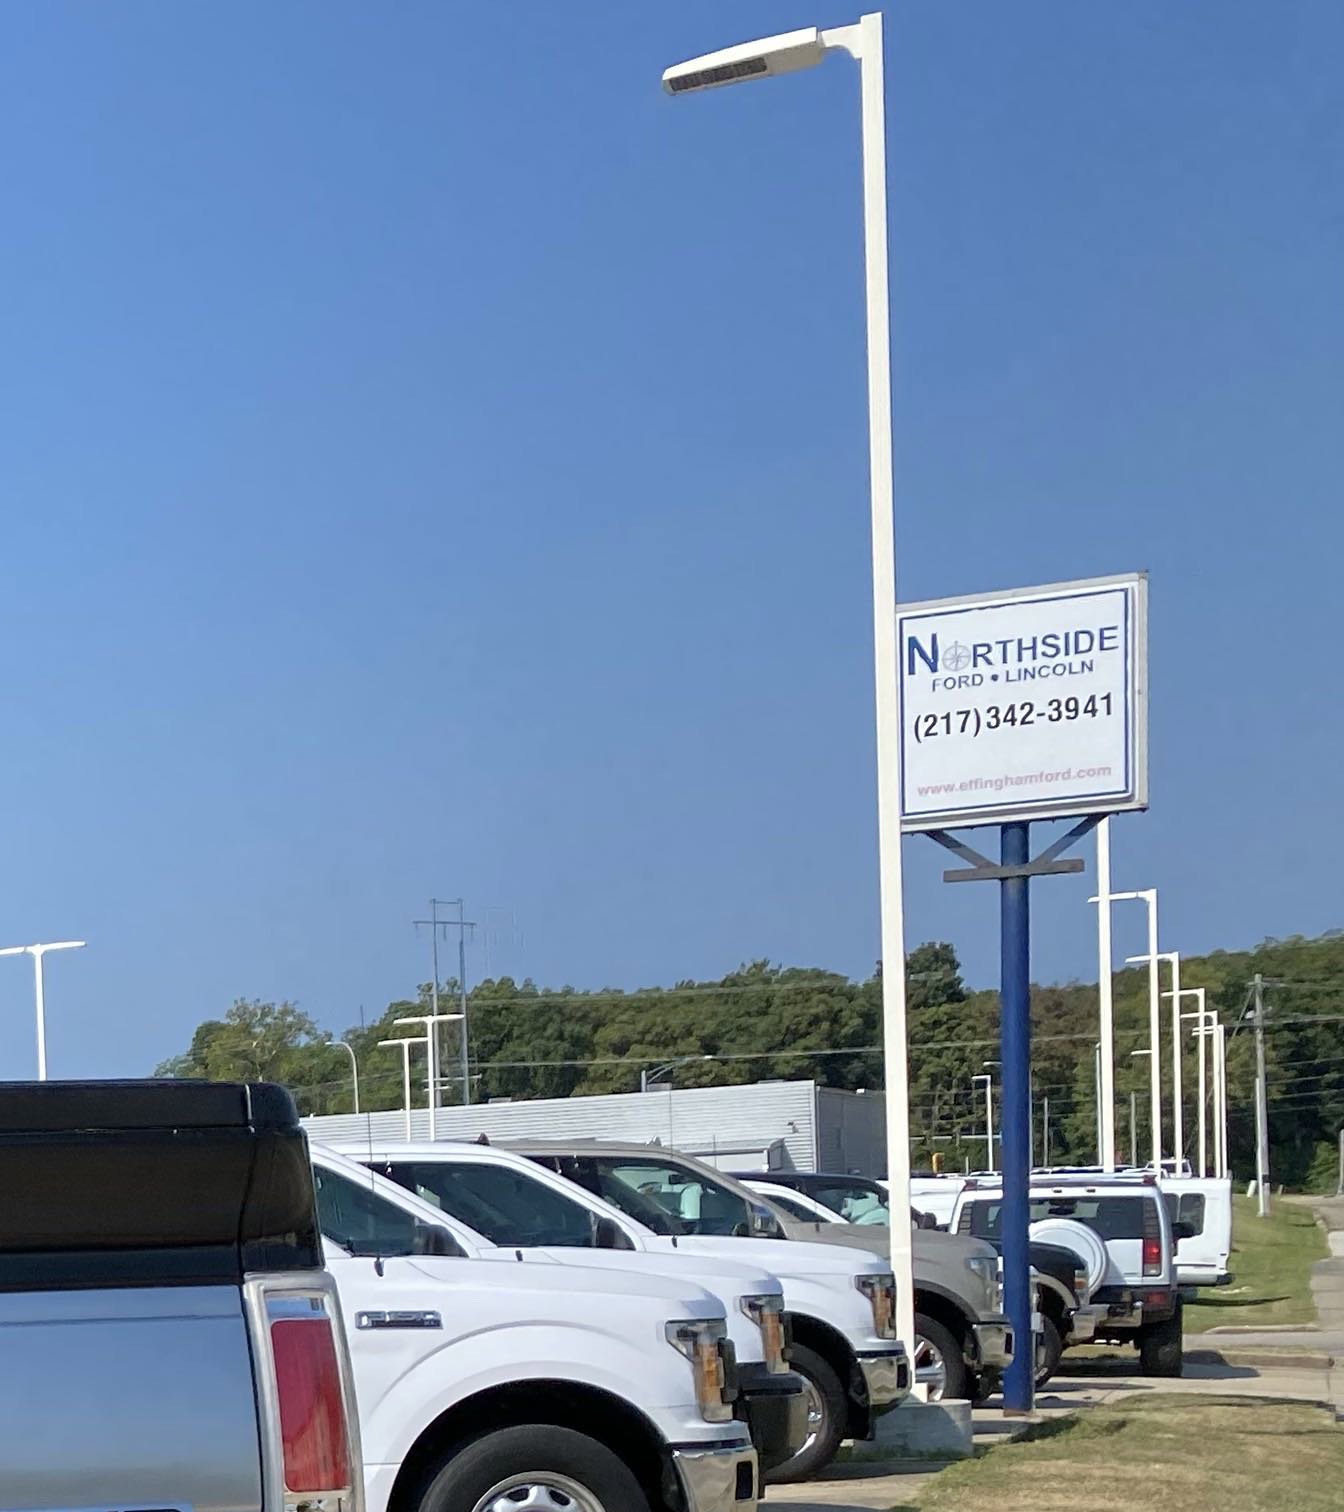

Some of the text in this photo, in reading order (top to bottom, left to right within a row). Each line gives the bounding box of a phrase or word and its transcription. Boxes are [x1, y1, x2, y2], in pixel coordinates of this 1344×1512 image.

[932, 659, 1094, 692] FORD LINCOLN
[917, 766, 1111, 796] www.effinghamford.com
